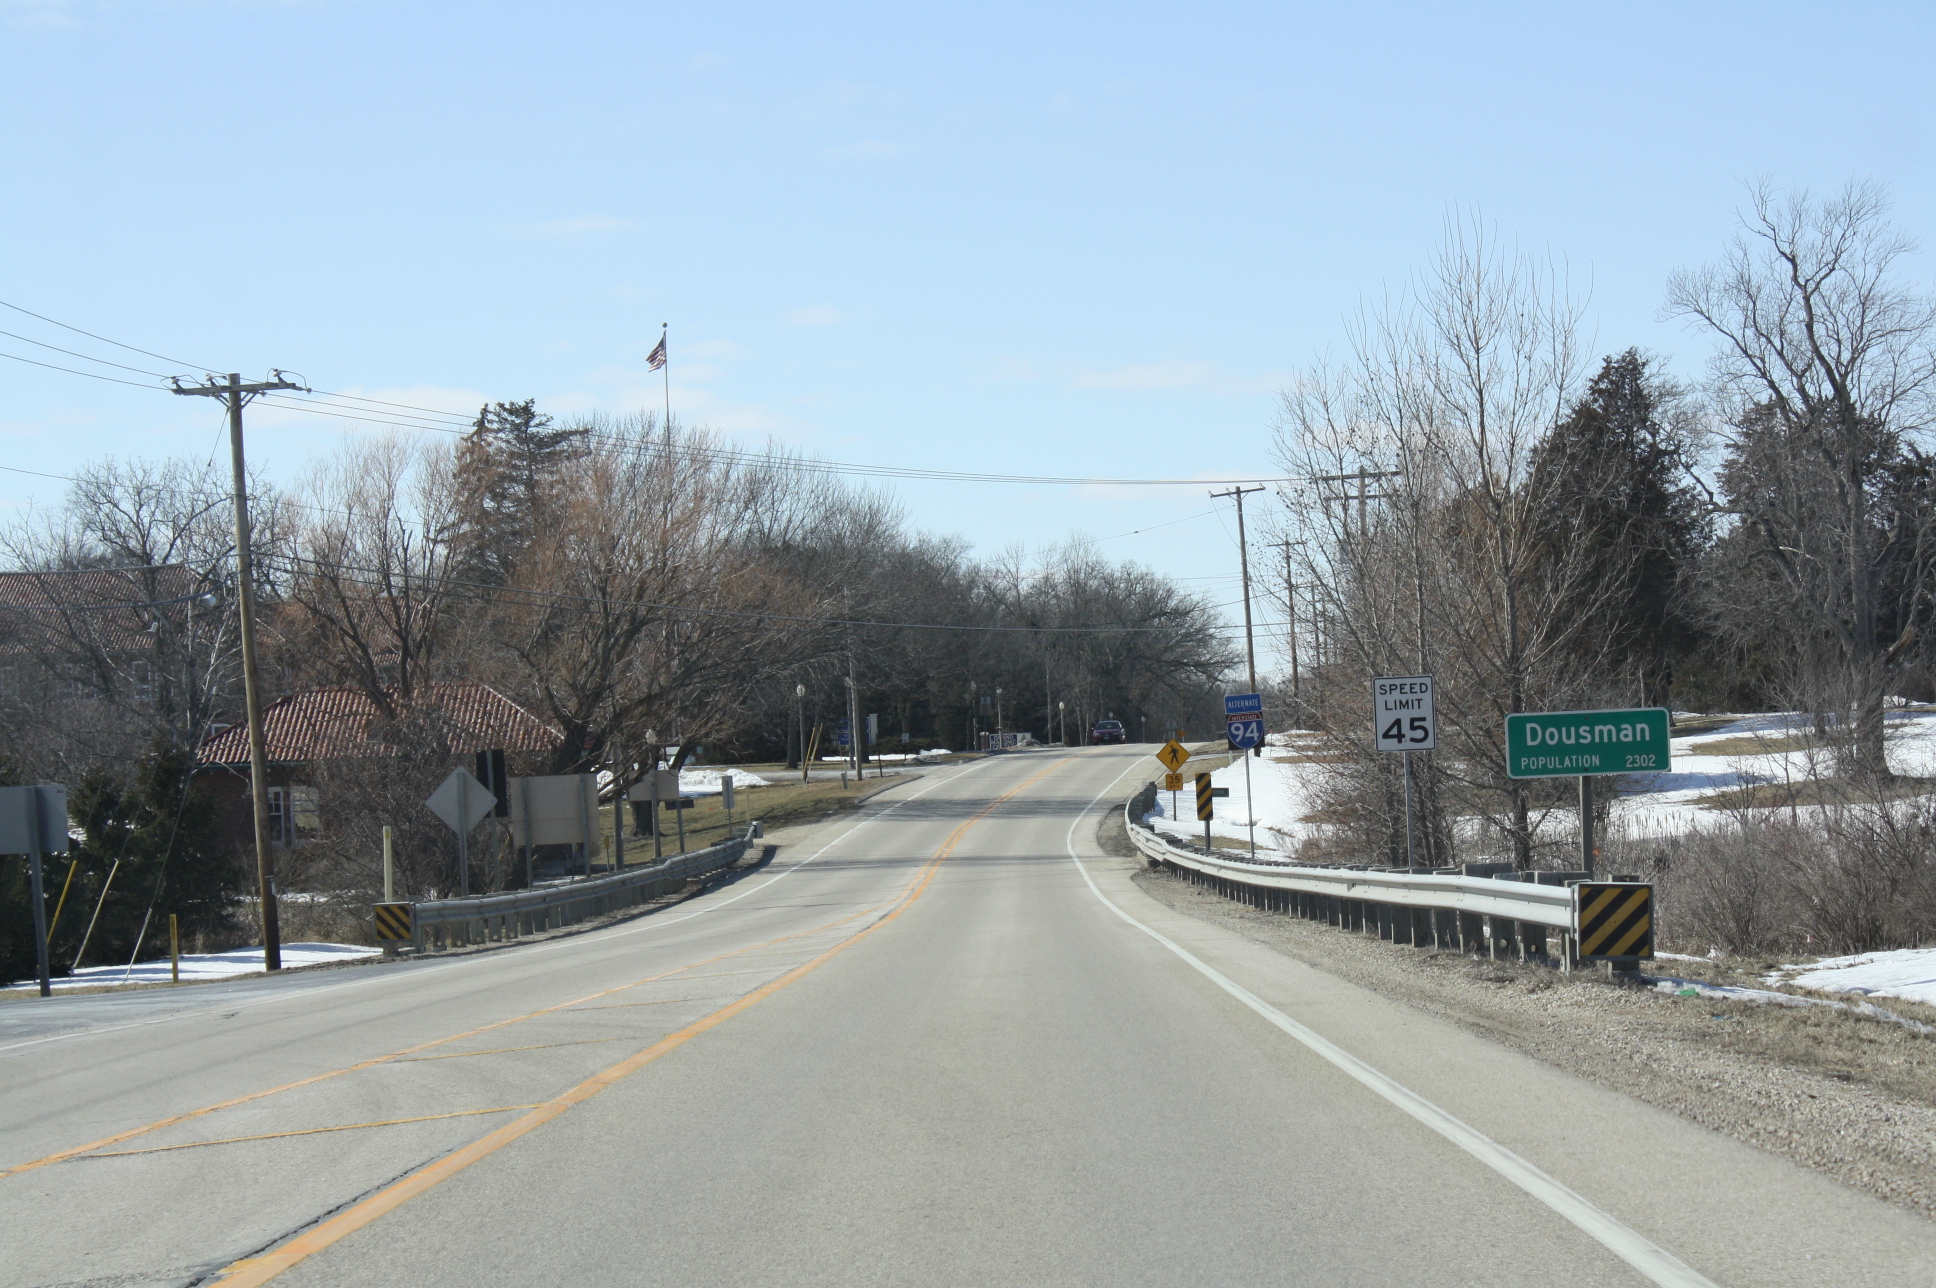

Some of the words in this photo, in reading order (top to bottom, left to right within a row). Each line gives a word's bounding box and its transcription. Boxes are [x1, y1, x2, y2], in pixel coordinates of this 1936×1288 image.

[1379, 682, 1428, 695] SPEED
[1228, 699, 1258, 708] ALTERNATE
[1384, 698, 1423, 711] LIMIT
[1231, 722, 1259, 742] 94
[1382, 717, 1429, 744] 45
[1526, 722, 1650, 746] Dousman
[1521, 754, 1600, 770] POPULATION
[1625, 754, 1656, 768] 2302
[1169, 775, 1181, 784] 35
